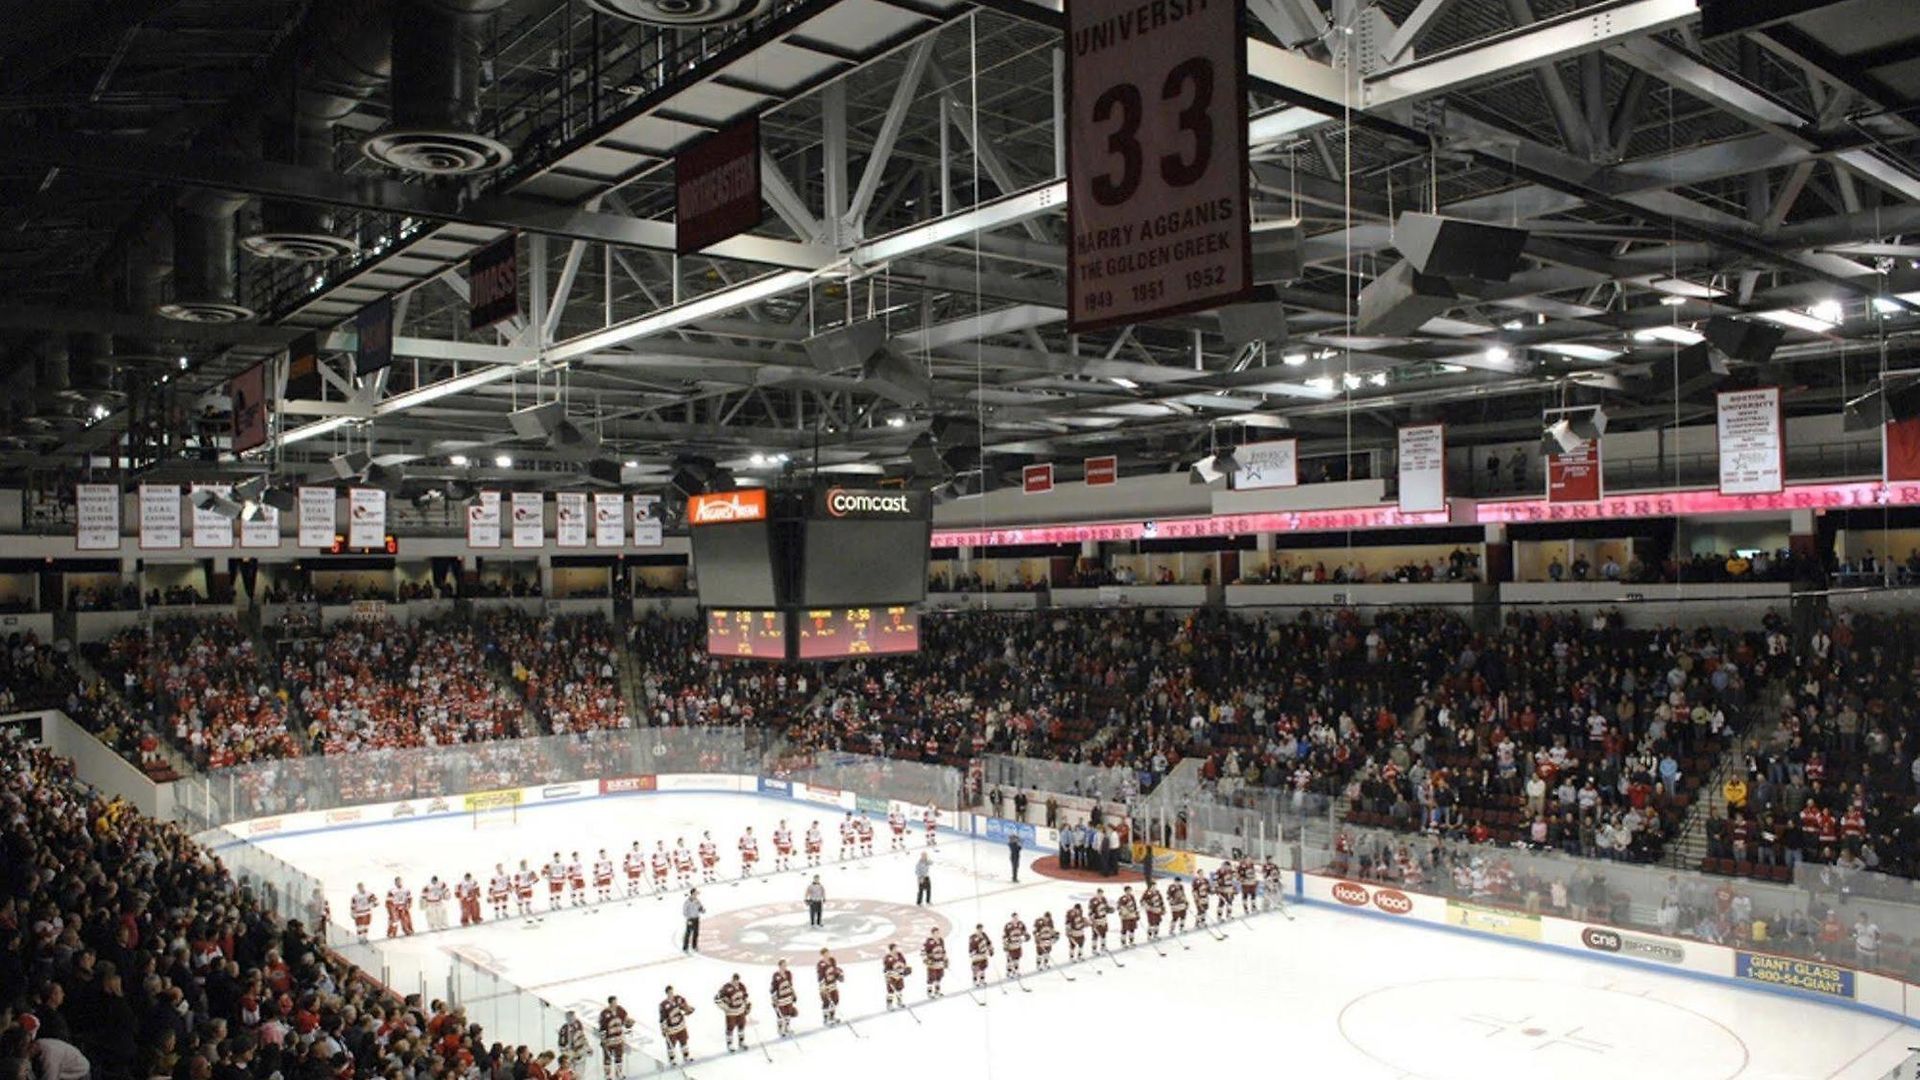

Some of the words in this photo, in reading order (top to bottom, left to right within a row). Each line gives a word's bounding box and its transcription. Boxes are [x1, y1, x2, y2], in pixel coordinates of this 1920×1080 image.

[1092, 56, 1214, 207] 33
[1076, 224, 1134, 256] HARRY
[1140, 198, 1233, 241] AGGANIS
[1106, 246, 1170, 277] GOLDEN
[1174, 231, 1230, 262] GREEK
[1132, 279, 1165, 303] 1951
[1186, 265, 1226, 292] 1952
[1504, 499, 1676, 521] TERRIERS
[1335, 886, 1366, 901] Hood
[1377, 893, 1409, 911] Hood
[1746, 967, 1844, 993] 1-800-54-GIANT
[1750, 953, 1791, 972] GIANT
[1794, 961, 1840, 981] GLASS
